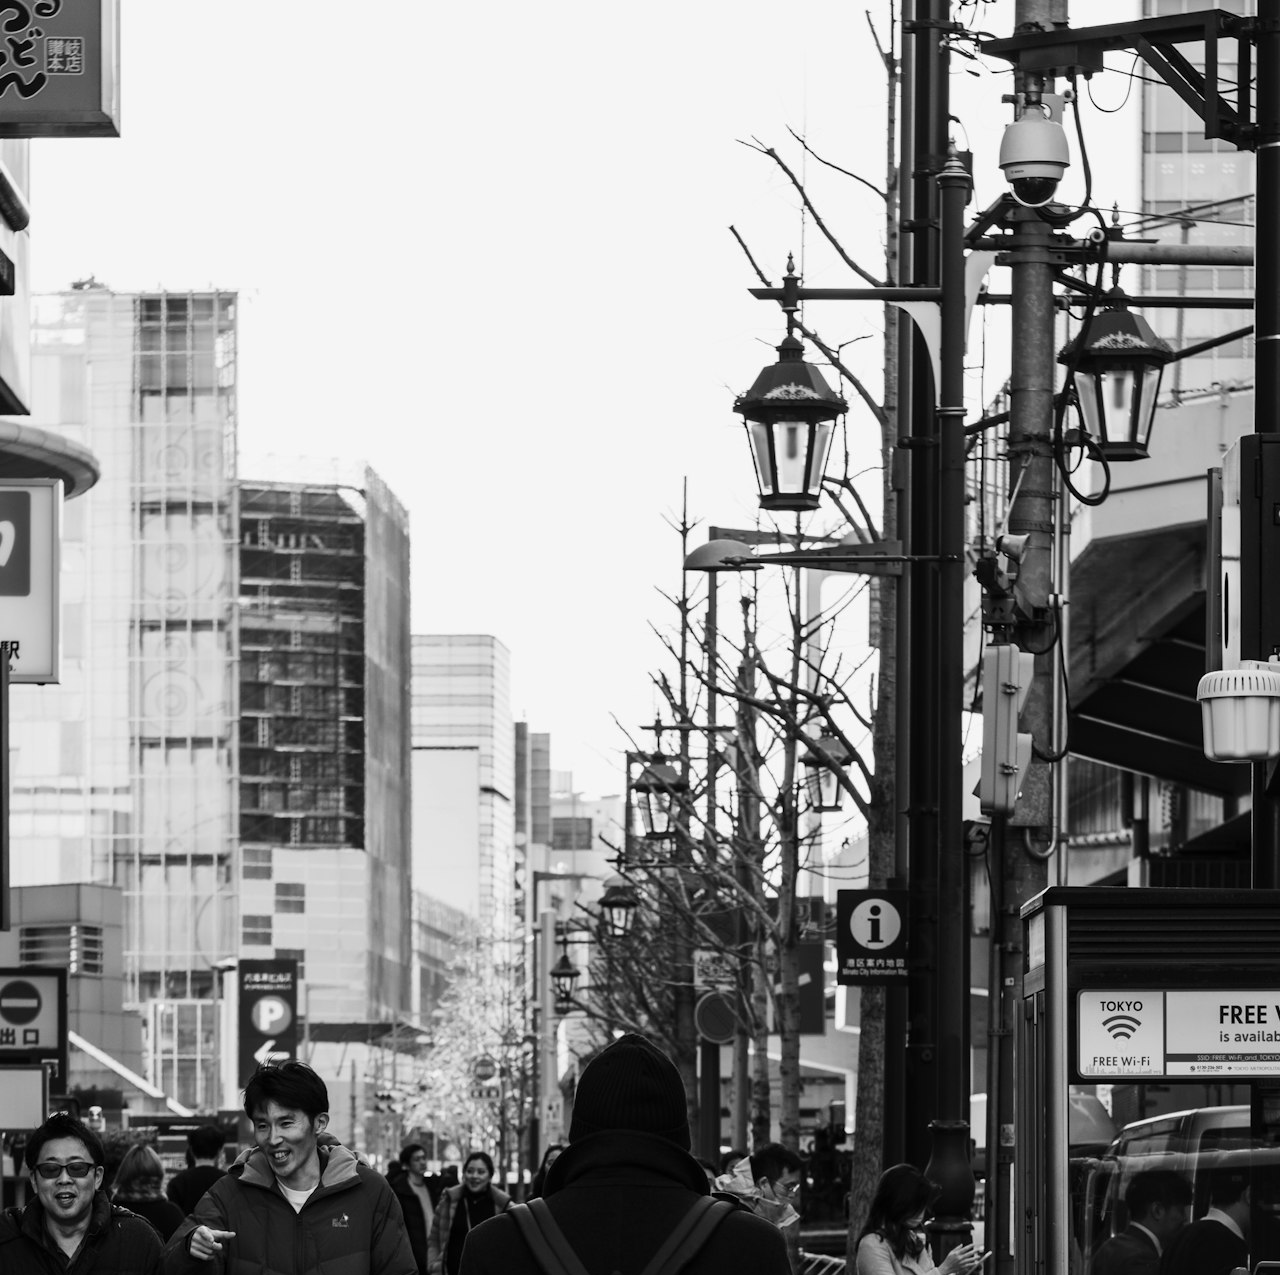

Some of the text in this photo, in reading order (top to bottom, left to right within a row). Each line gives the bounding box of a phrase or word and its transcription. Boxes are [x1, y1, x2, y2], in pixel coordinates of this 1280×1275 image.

[1100, 1001, 1143, 1012] TOKYO
[259, 1000, 285, 1032] P
[1219, 1005, 1267, 1025] FREE
[0, 1027, 39, 1046] 出口
[1220, 1031, 1230, 1043] is
[1093, 1056, 1150, 1067] FREE Wi-Fi
